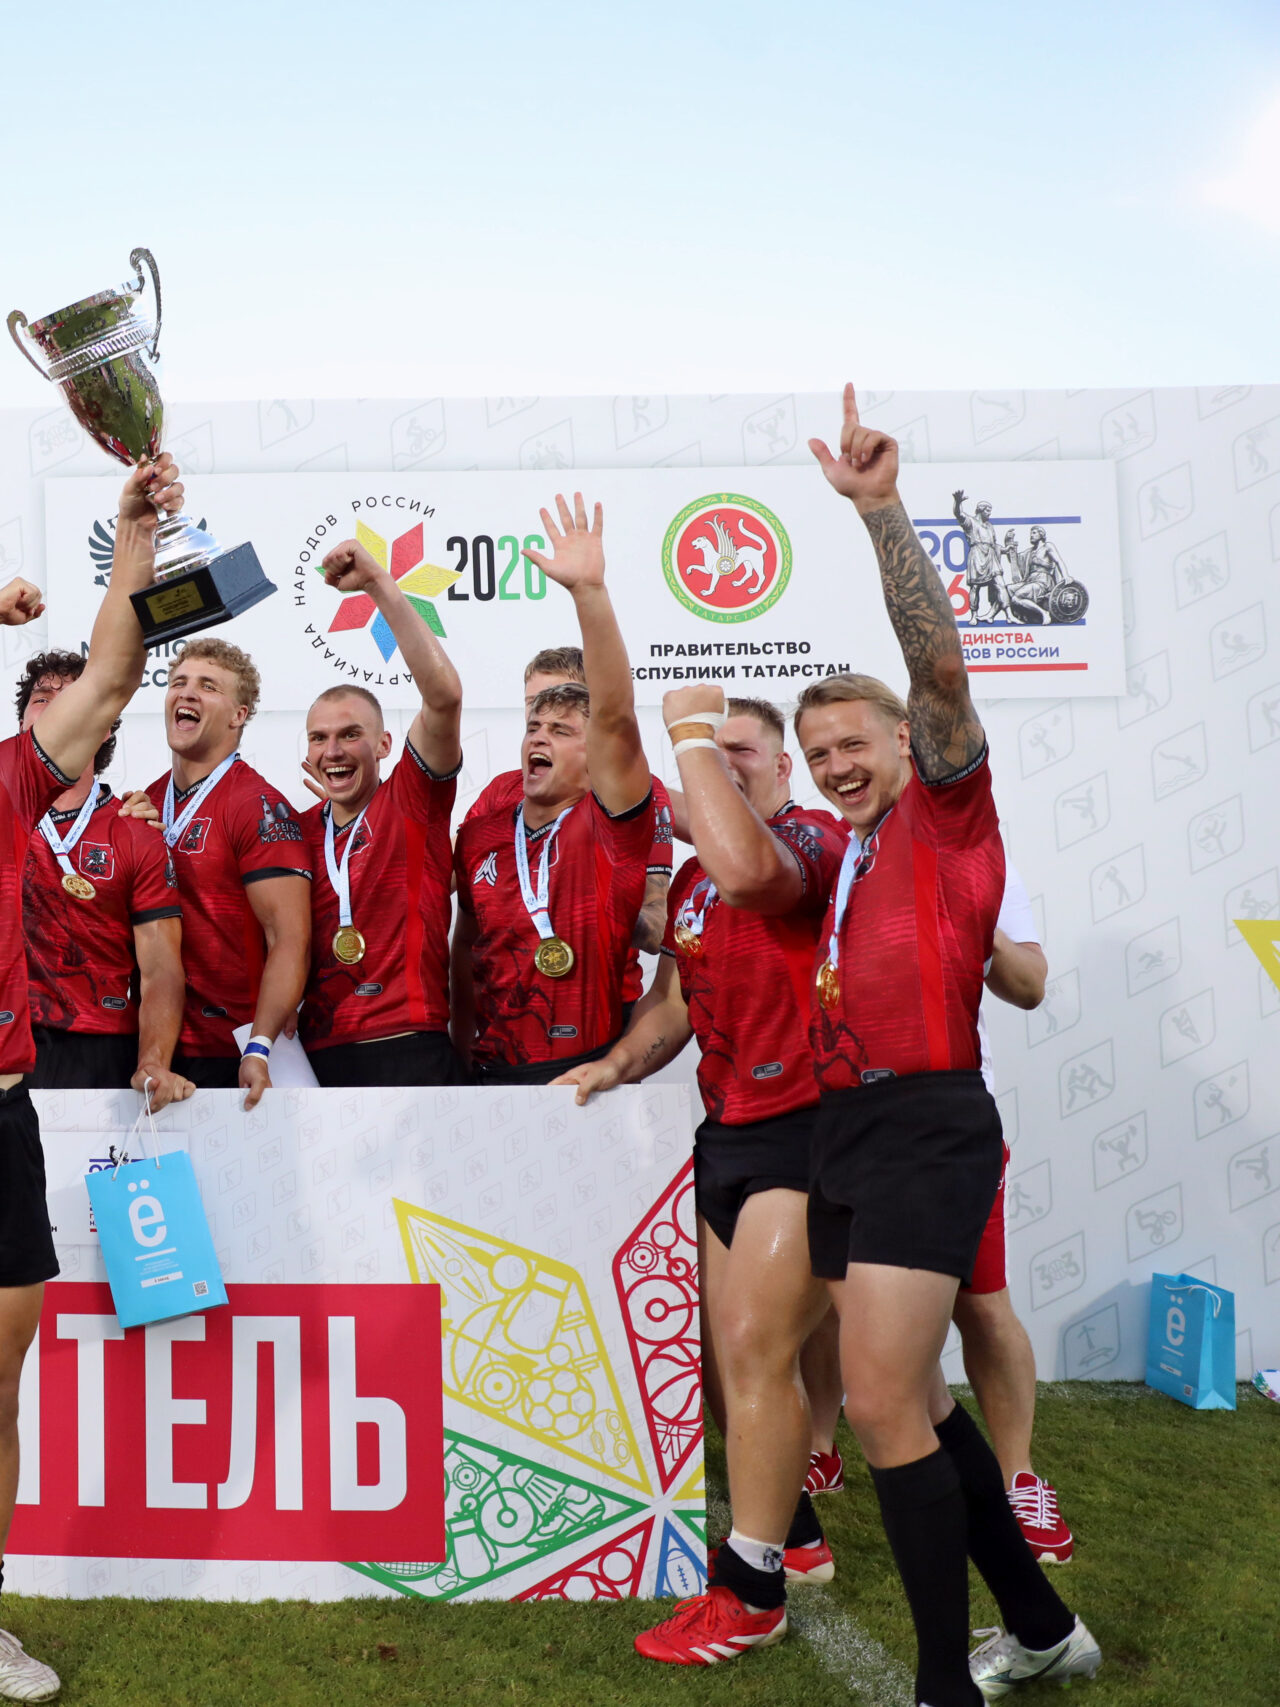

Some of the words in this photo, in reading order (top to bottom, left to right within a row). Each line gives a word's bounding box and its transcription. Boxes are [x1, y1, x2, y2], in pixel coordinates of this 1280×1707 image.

[351, 495, 436, 519] РОССИИ
[294, 513, 338, 606] НАРОДОВ
[446, 534, 547, 601] 2026
[650, 641, 812, 657] ПРАВИТЕЛЬСТВО
[960, 632, 1035, 646] ДИНСТВА
[304, 623, 413, 686] АРТАКИАДА
[996, 646, 1061, 659] РОССИИ
[630, 665, 736, 680] СПУБЛИКИ
[741, 663, 851, 678] ТАТАРСТАН
